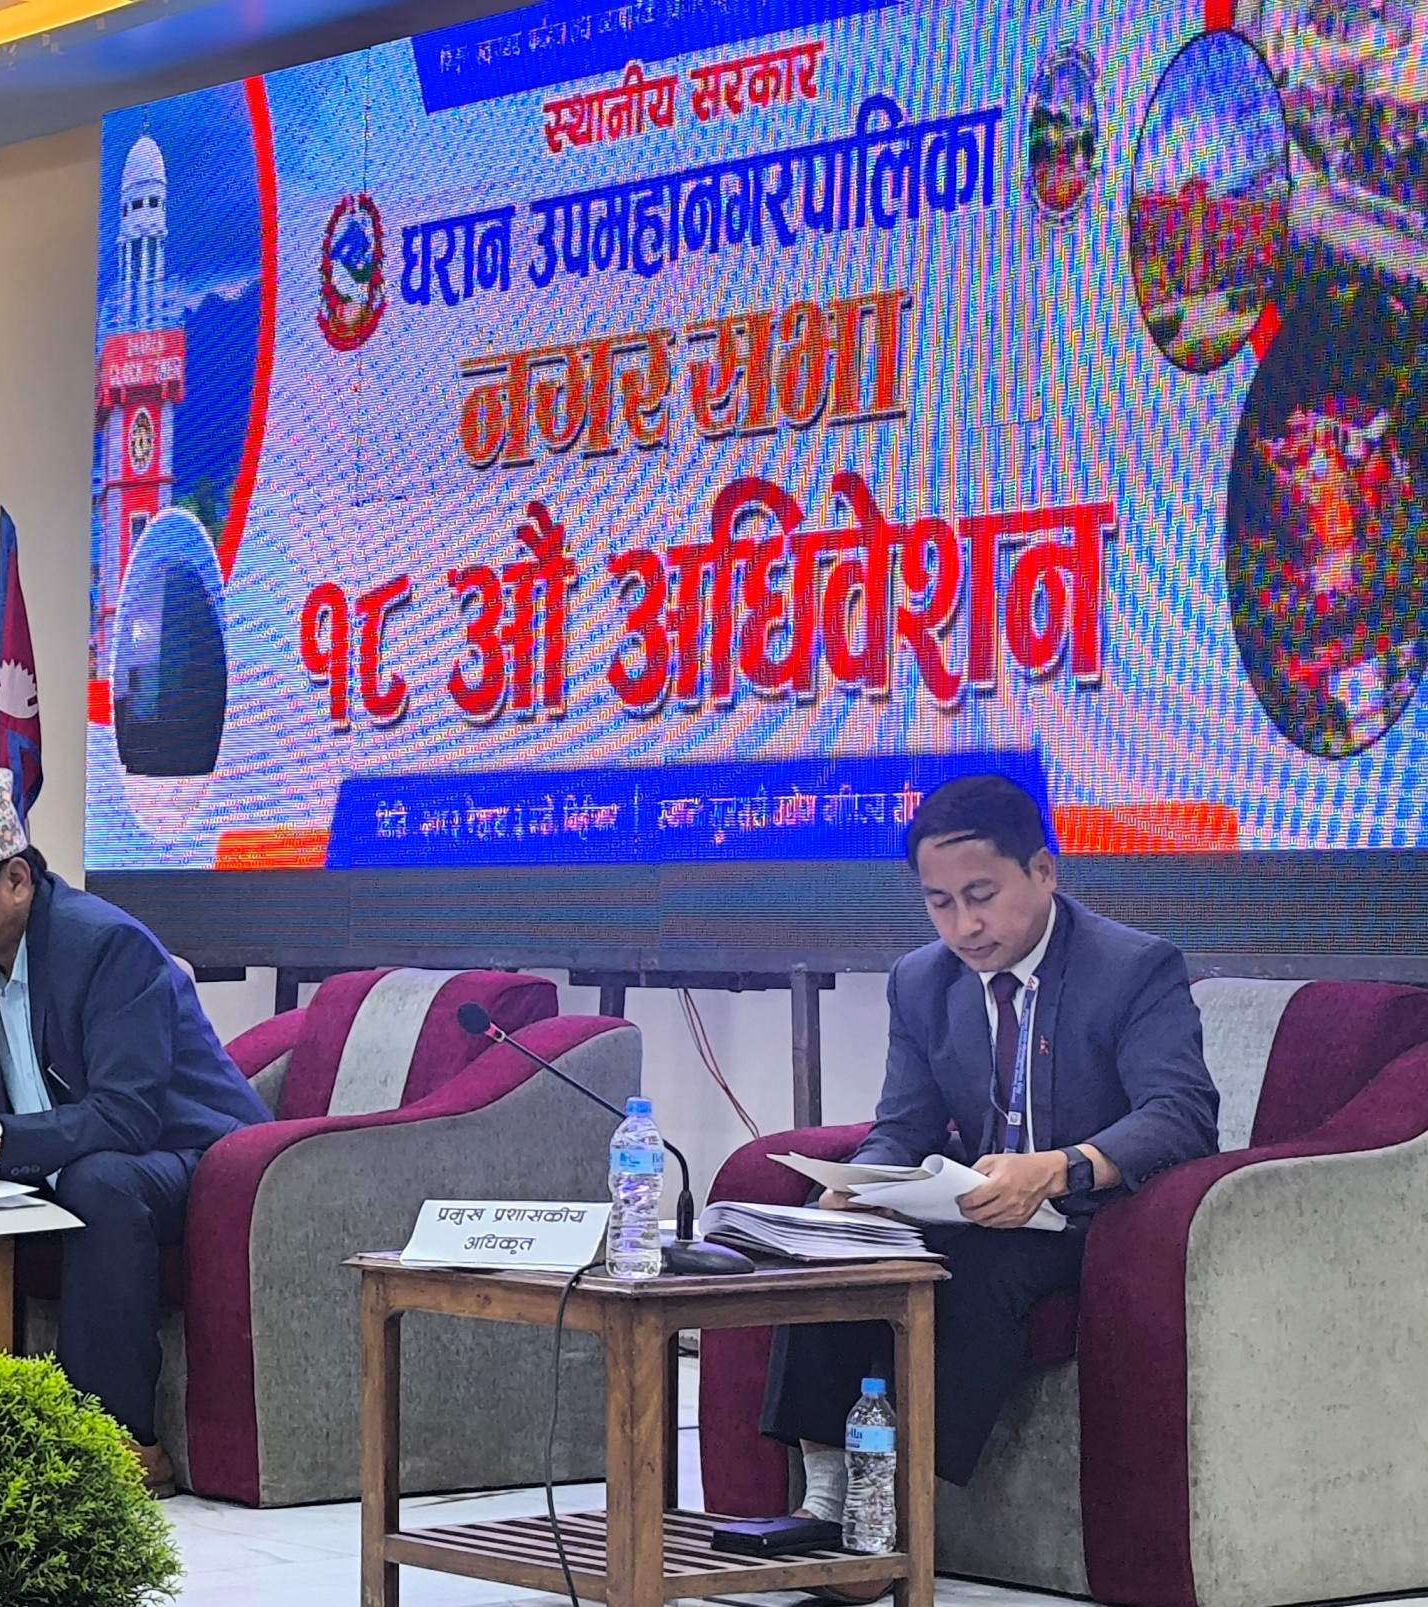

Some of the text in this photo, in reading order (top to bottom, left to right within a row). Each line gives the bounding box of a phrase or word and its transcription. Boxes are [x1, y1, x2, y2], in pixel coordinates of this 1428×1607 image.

[542, 41, 824, 155] स्थानीय सरकार
[400, 92, 1002, 306] धरान उपमहानगरपालिका
[459, 290, 910, 470] नगर सभा
[299, 576, 412, 732] १८
[606, 472, 1117, 713] अधिवेशन
[436, 1206, 588, 1226] प्रमुख प्रशासकीय
[464, 1233, 536, 1255] अधिकृत
